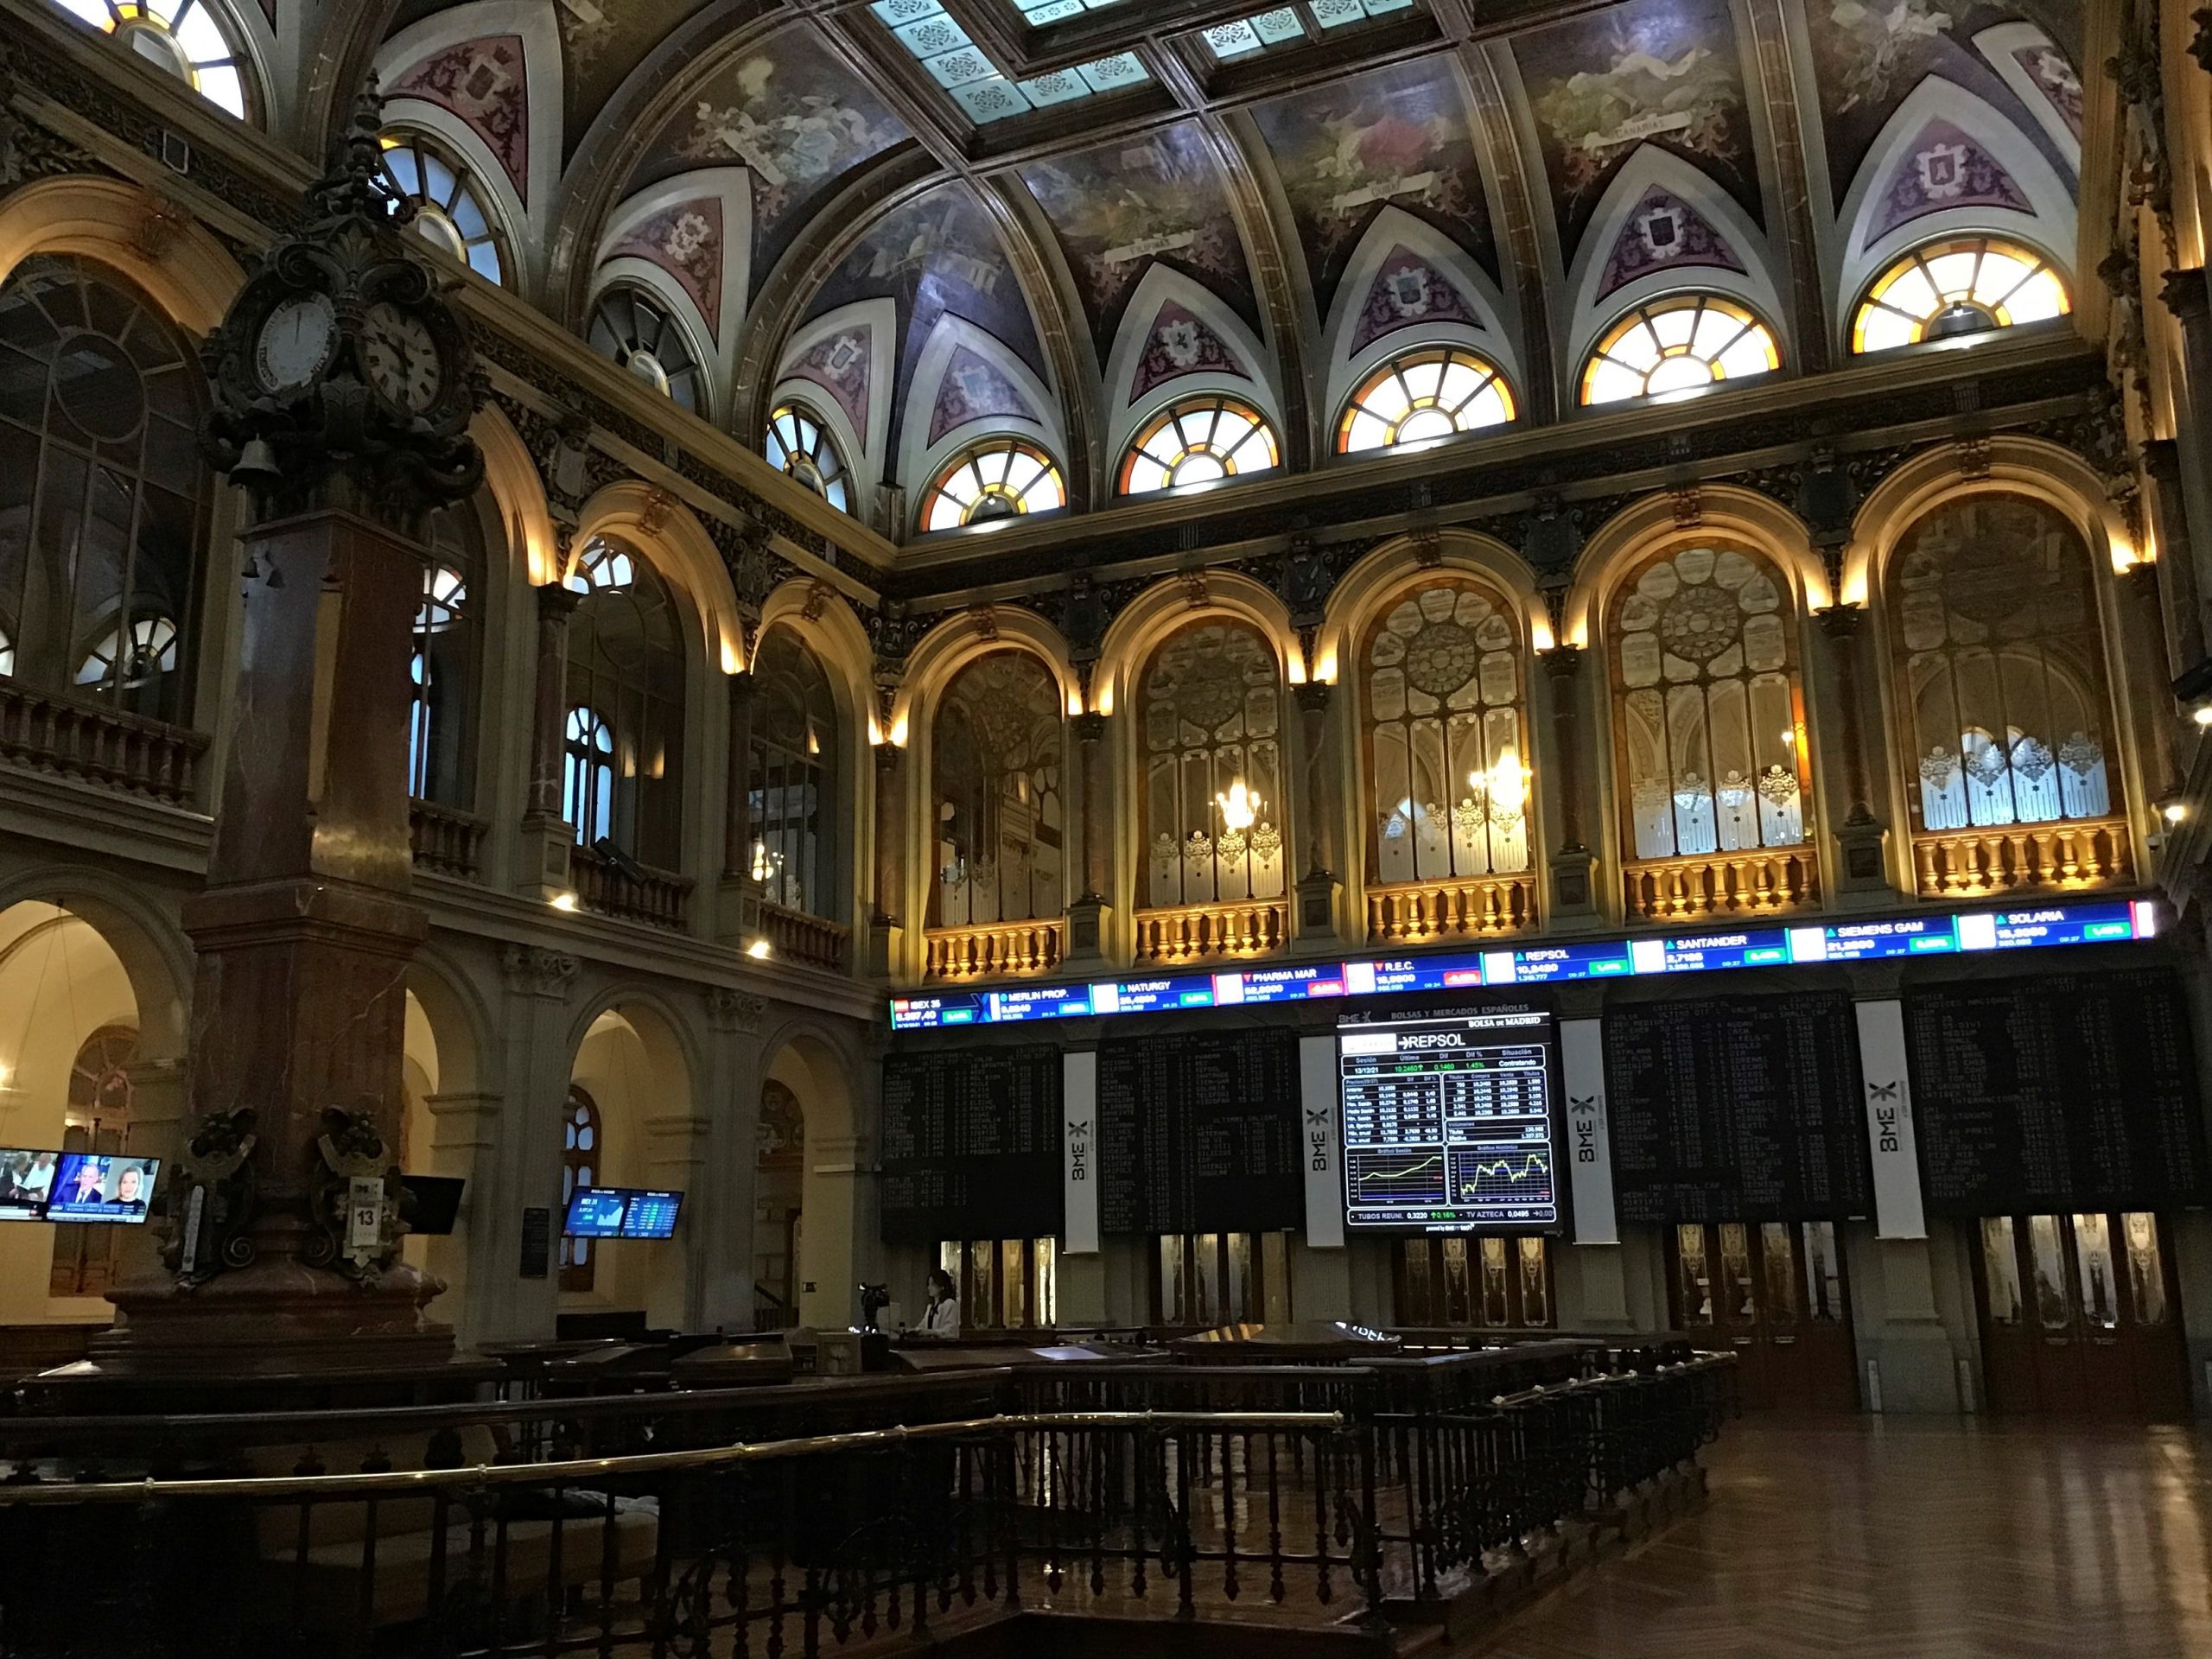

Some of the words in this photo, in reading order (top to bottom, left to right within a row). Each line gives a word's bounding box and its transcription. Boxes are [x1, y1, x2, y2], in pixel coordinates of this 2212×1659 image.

[1615, 120, 1664, 138] CANARIAS
[2009, 911, 2064, 924] SOLARIA
[1838, 925, 1892, 937] SIEMENS
[1895, 922, 1923, 932] GAM
[1677, 935, 1747, 949] SANTANDER
[1526, 950, 1569, 961] REPSOL
[1385, 962, 1414, 972] R.E.C.
[1253, 971, 1294, 982] PHARMA
[1295, 969, 1317, 979] MAR
[1128, 982, 1171, 993] NATURGY
[1008, 991, 1040, 1001] MERLIN
[1042, 989, 1069, 999] PROP.
[910, 1001, 930, 1010] IBEX
[931, 999, 941, 1008] 35
[1391, 1009, 1421, 1020] BOLSAS
[1433, 1006, 1478, 1017] MERCADOS
[1481, 1003, 1529, 1014] ESPAÑOLES
[1338, 1014, 1359, 1024] BME
[1468, 1020, 1495, 1028] BOLSA
[1505, 1016, 1541, 1026] MADRID
[1408, 1033, 1466, 1048] REPSOL
[1400, 1052, 1420, 1061] Último
[1502, 1047, 1532, 1057] Situación
[1499, 1059, 1536, 1068] Contratando
[1876, 1107, 1898, 1153] BME
[1576, 1120, 1594, 1162] BME
[1311, 1130, 1326, 1171] BME
[1071, 1142, 1084, 1180] BME
[358, 1211, 374, 1225] 13
[1407, 1211, 1427, 1220] 0,3220
